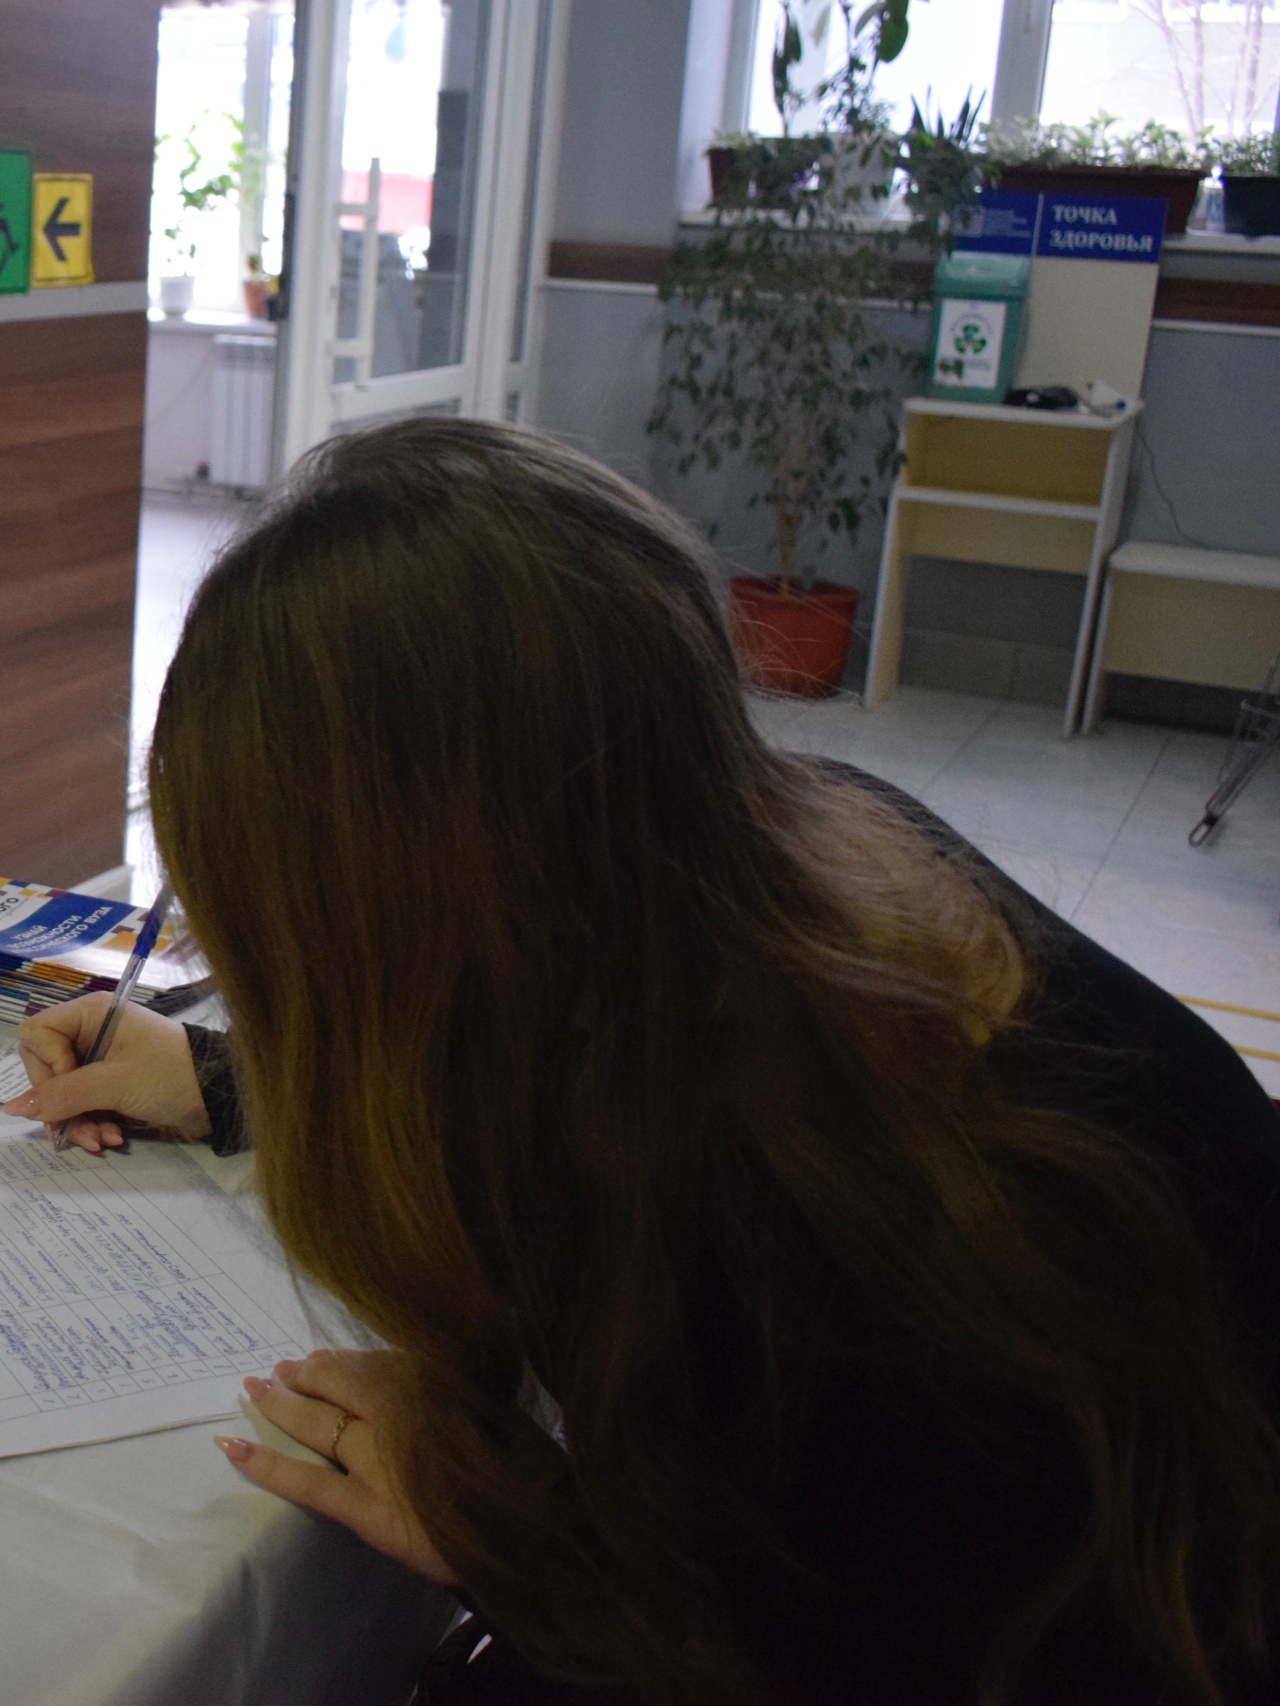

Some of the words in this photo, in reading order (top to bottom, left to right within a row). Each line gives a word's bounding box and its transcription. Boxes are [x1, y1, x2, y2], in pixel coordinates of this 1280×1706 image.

[1053, 205, 1117, 225] ТОЧКА
[1050, 230, 1153, 253] ЗДОРОВЬЯ
[87, 906, 114, 924] ВУЗА
